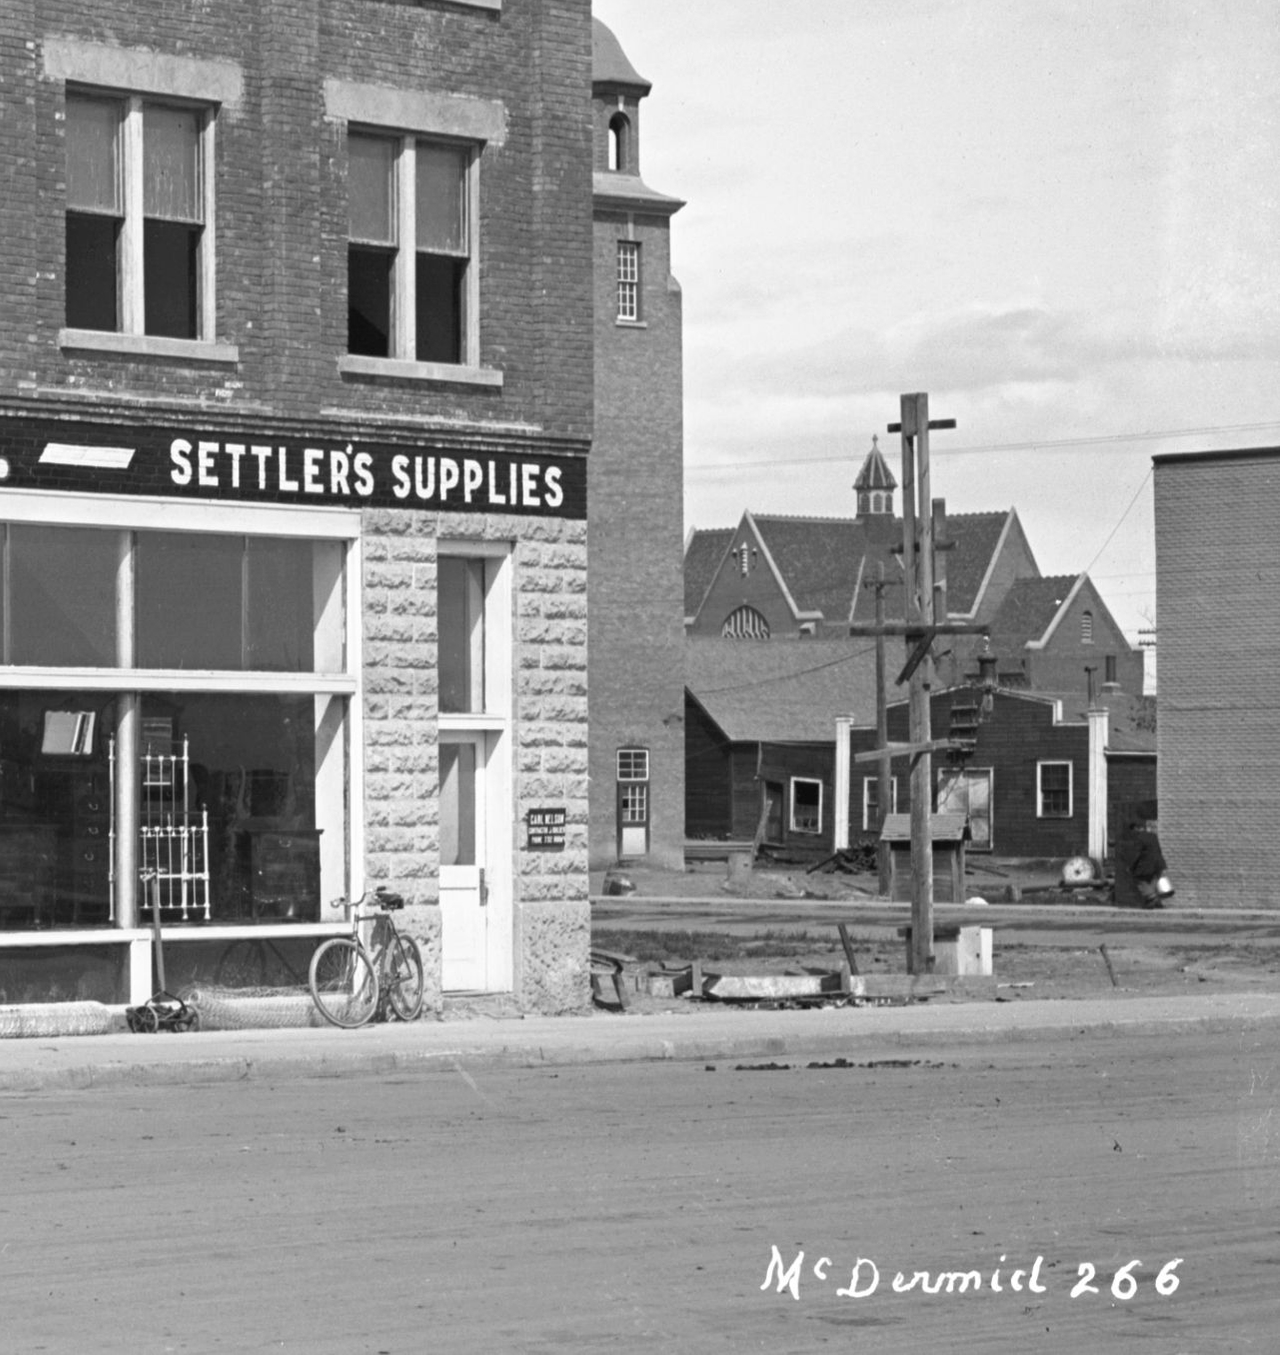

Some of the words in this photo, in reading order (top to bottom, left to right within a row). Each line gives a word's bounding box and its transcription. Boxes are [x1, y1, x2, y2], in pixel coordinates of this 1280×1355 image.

[170, 438, 374, 496] SETTLER'S
[391, 453, 565, 508] SUPPLIES
[530, 814, 543, 825] CARL
[545, 814, 564, 824] NELSON
